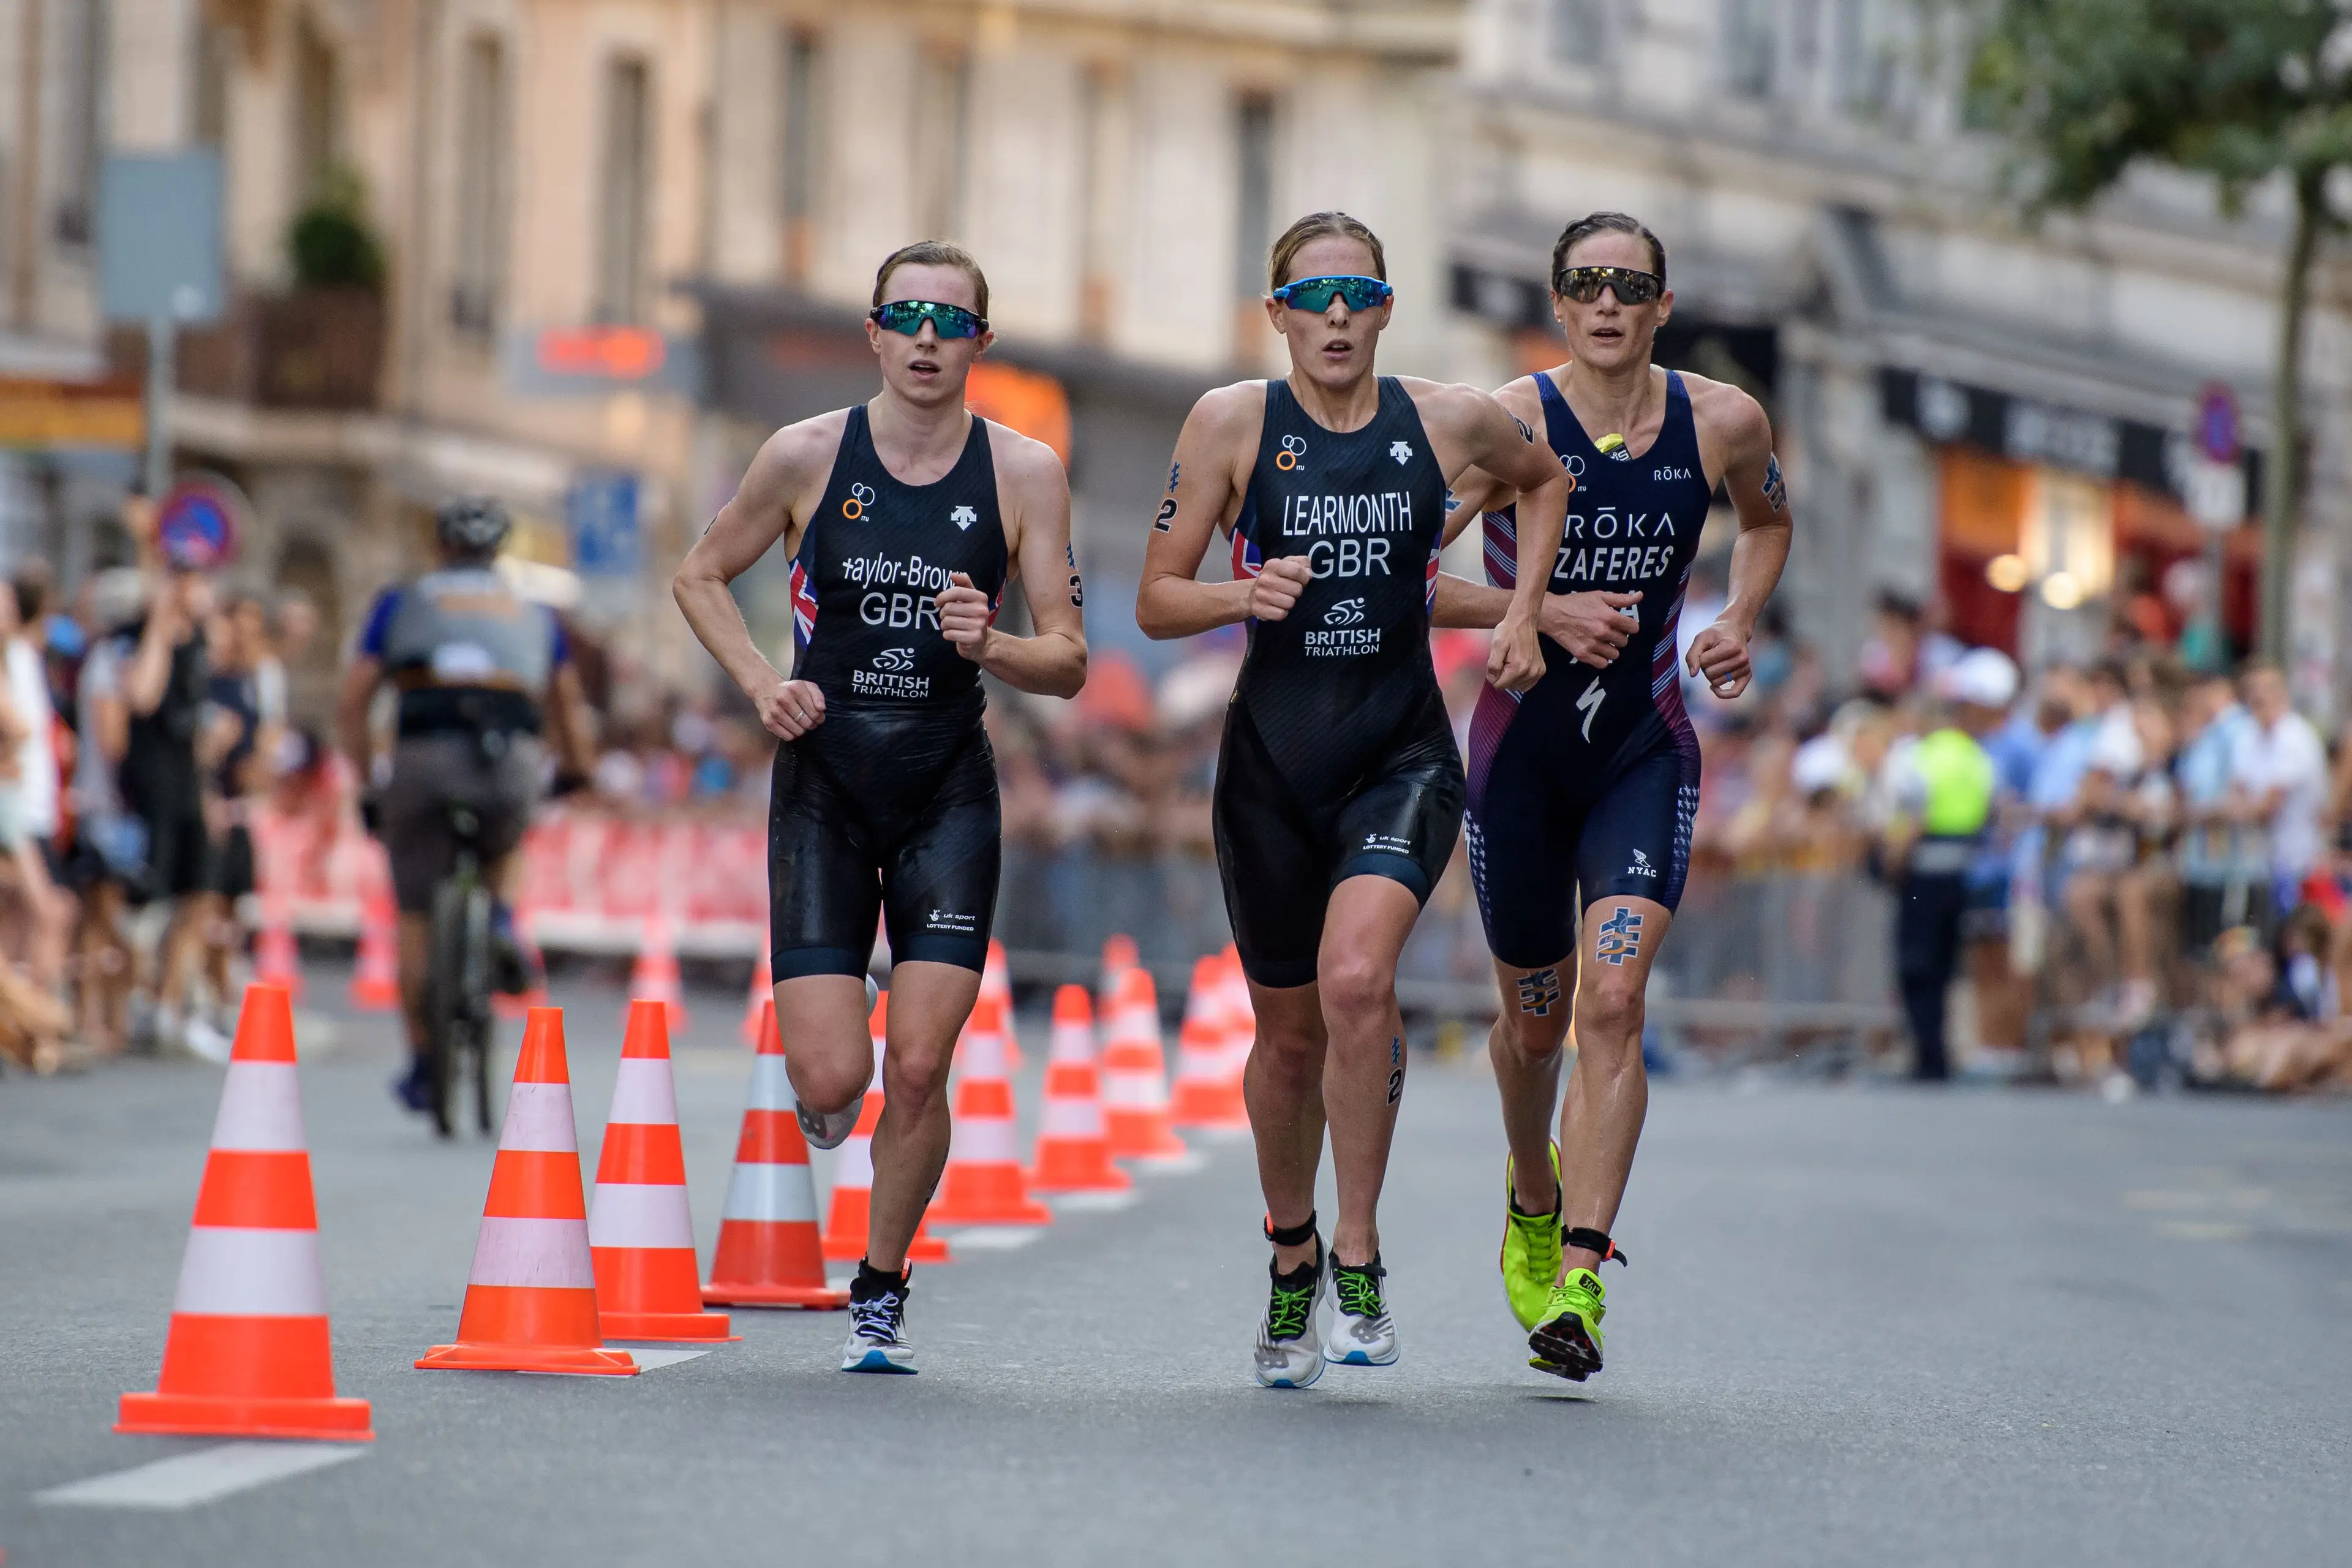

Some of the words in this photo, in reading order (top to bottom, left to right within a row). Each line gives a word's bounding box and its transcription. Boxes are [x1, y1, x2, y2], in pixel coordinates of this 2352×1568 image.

[1153, 498, 1178, 533] 2
[1283, 491, 1412, 535] LEARMONTH
[1308, 538, 1391, 579] GBR
[1555, 546, 1674, 581] ZAFERES
[1069, 574, 1083, 608] 3
[859, 592, 940, 630] GBR
[1304, 644, 1379, 657] TRIATHLON
[1305, 628, 1381, 645] BRITISH
[851, 683, 929, 698] TRIATHLON
[853, 669, 930, 689] BRITISH
[1390, 837, 1411, 845] sport
[1627, 866, 1657, 878] NYAC
[1387, 1068, 1403, 1106] 2
